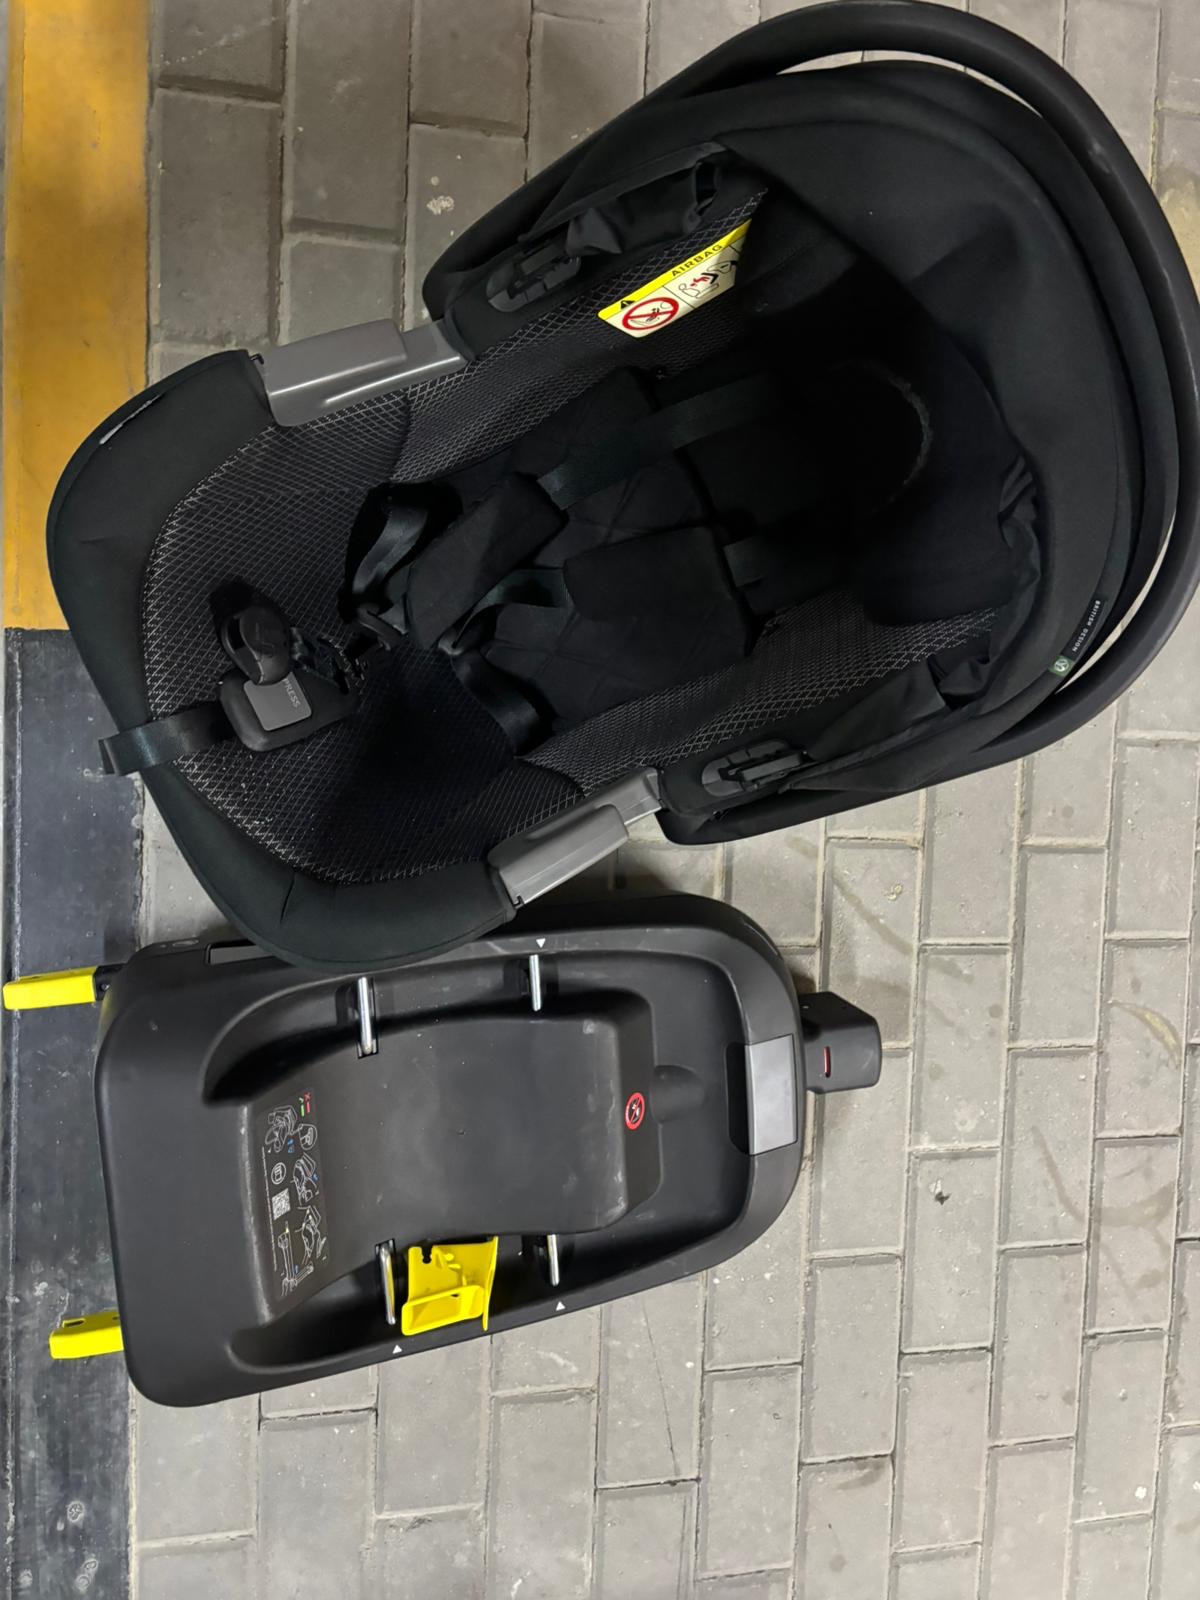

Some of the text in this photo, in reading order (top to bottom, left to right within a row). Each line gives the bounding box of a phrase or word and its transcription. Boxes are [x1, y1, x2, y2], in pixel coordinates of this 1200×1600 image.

[671, 244, 723, 277] AIRBAG
[1071, 628, 1089, 652] DESIGN
[283, 678, 301, 708] PRESS
